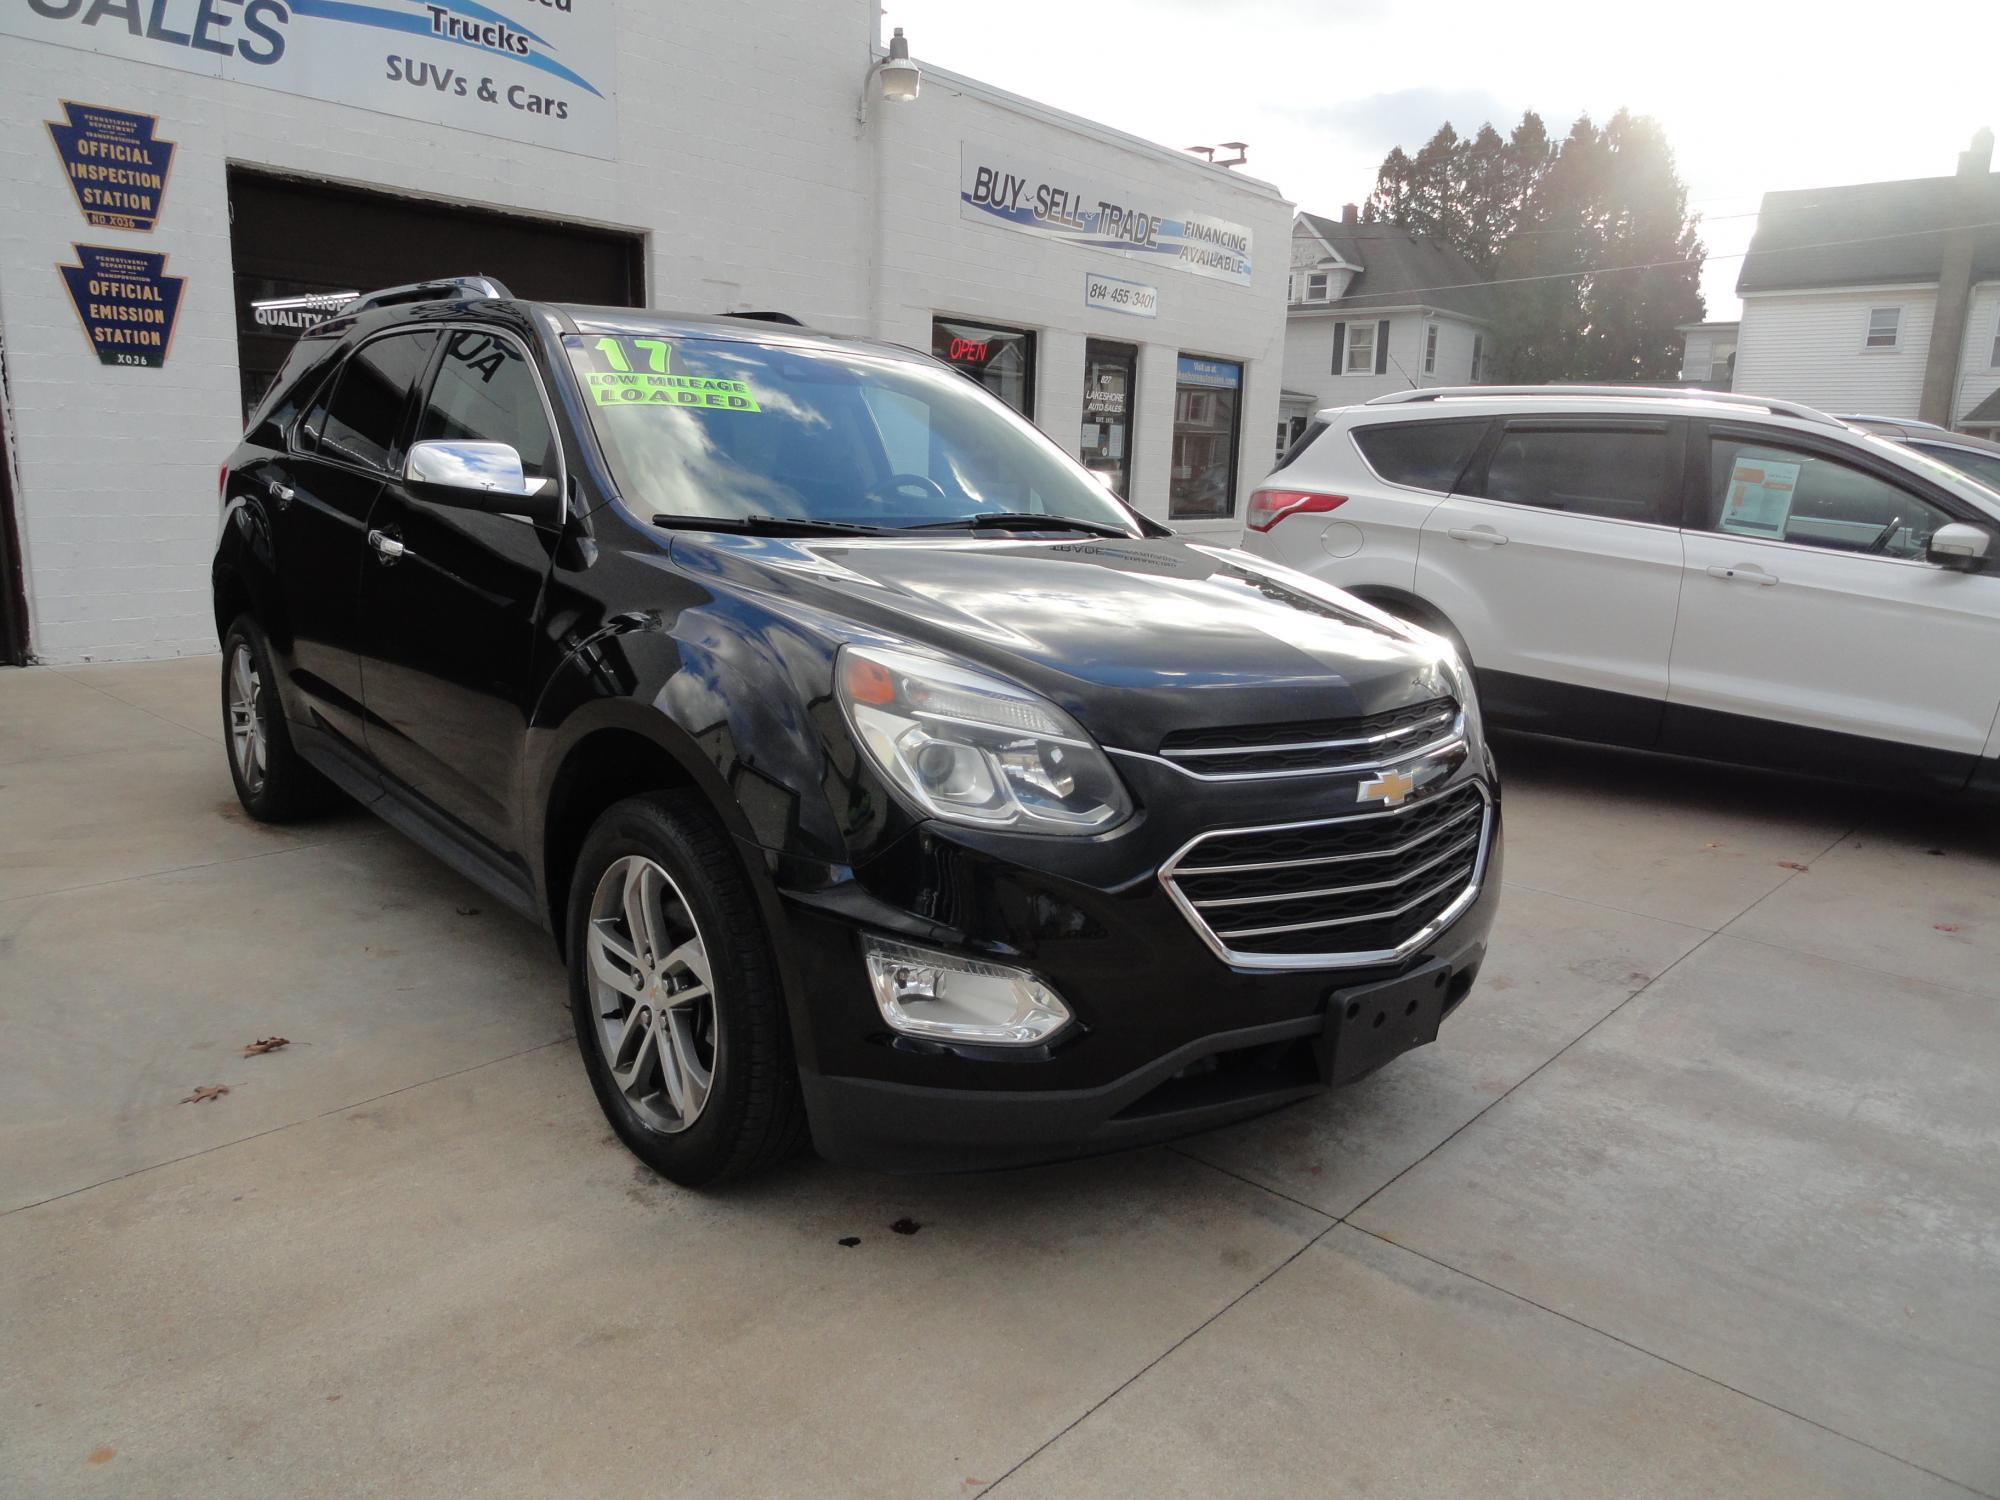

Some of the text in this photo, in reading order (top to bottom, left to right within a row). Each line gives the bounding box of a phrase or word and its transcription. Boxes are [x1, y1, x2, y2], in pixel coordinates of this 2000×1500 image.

[427, 4, 529, 54] Trucks
[386, 54, 569, 120] SUVs & Cars
[78, 139, 153, 165] OFFICIAL
[69, 162, 161, 189] INSPECTION
[83, 187, 152, 210] STATION
[972, 166, 1162, 248] BUY SELL TRADE
[1183, 220, 1247, 252] FINANCING
[1179, 244, 1244, 275] AVAILABLE
[89, 280, 163, 301] OFFICIAL
[89, 303, 165, 324] EMISSION
[255, 308, 322, 328] QUALITY
[94, 326, 161, 346] STATION
[117, 354, 148, 366] X036
[595, 337, 671, 374] 17
[950, 337, 987, 361] OPEN
[590, 375, 746, 394] LOW MILEAGE
[600, 388, 751, 409] LOADED
[1086, 390, 1125, 403] LAKESHORE
[1088, 402, 1122, 413] AUTO SALES
